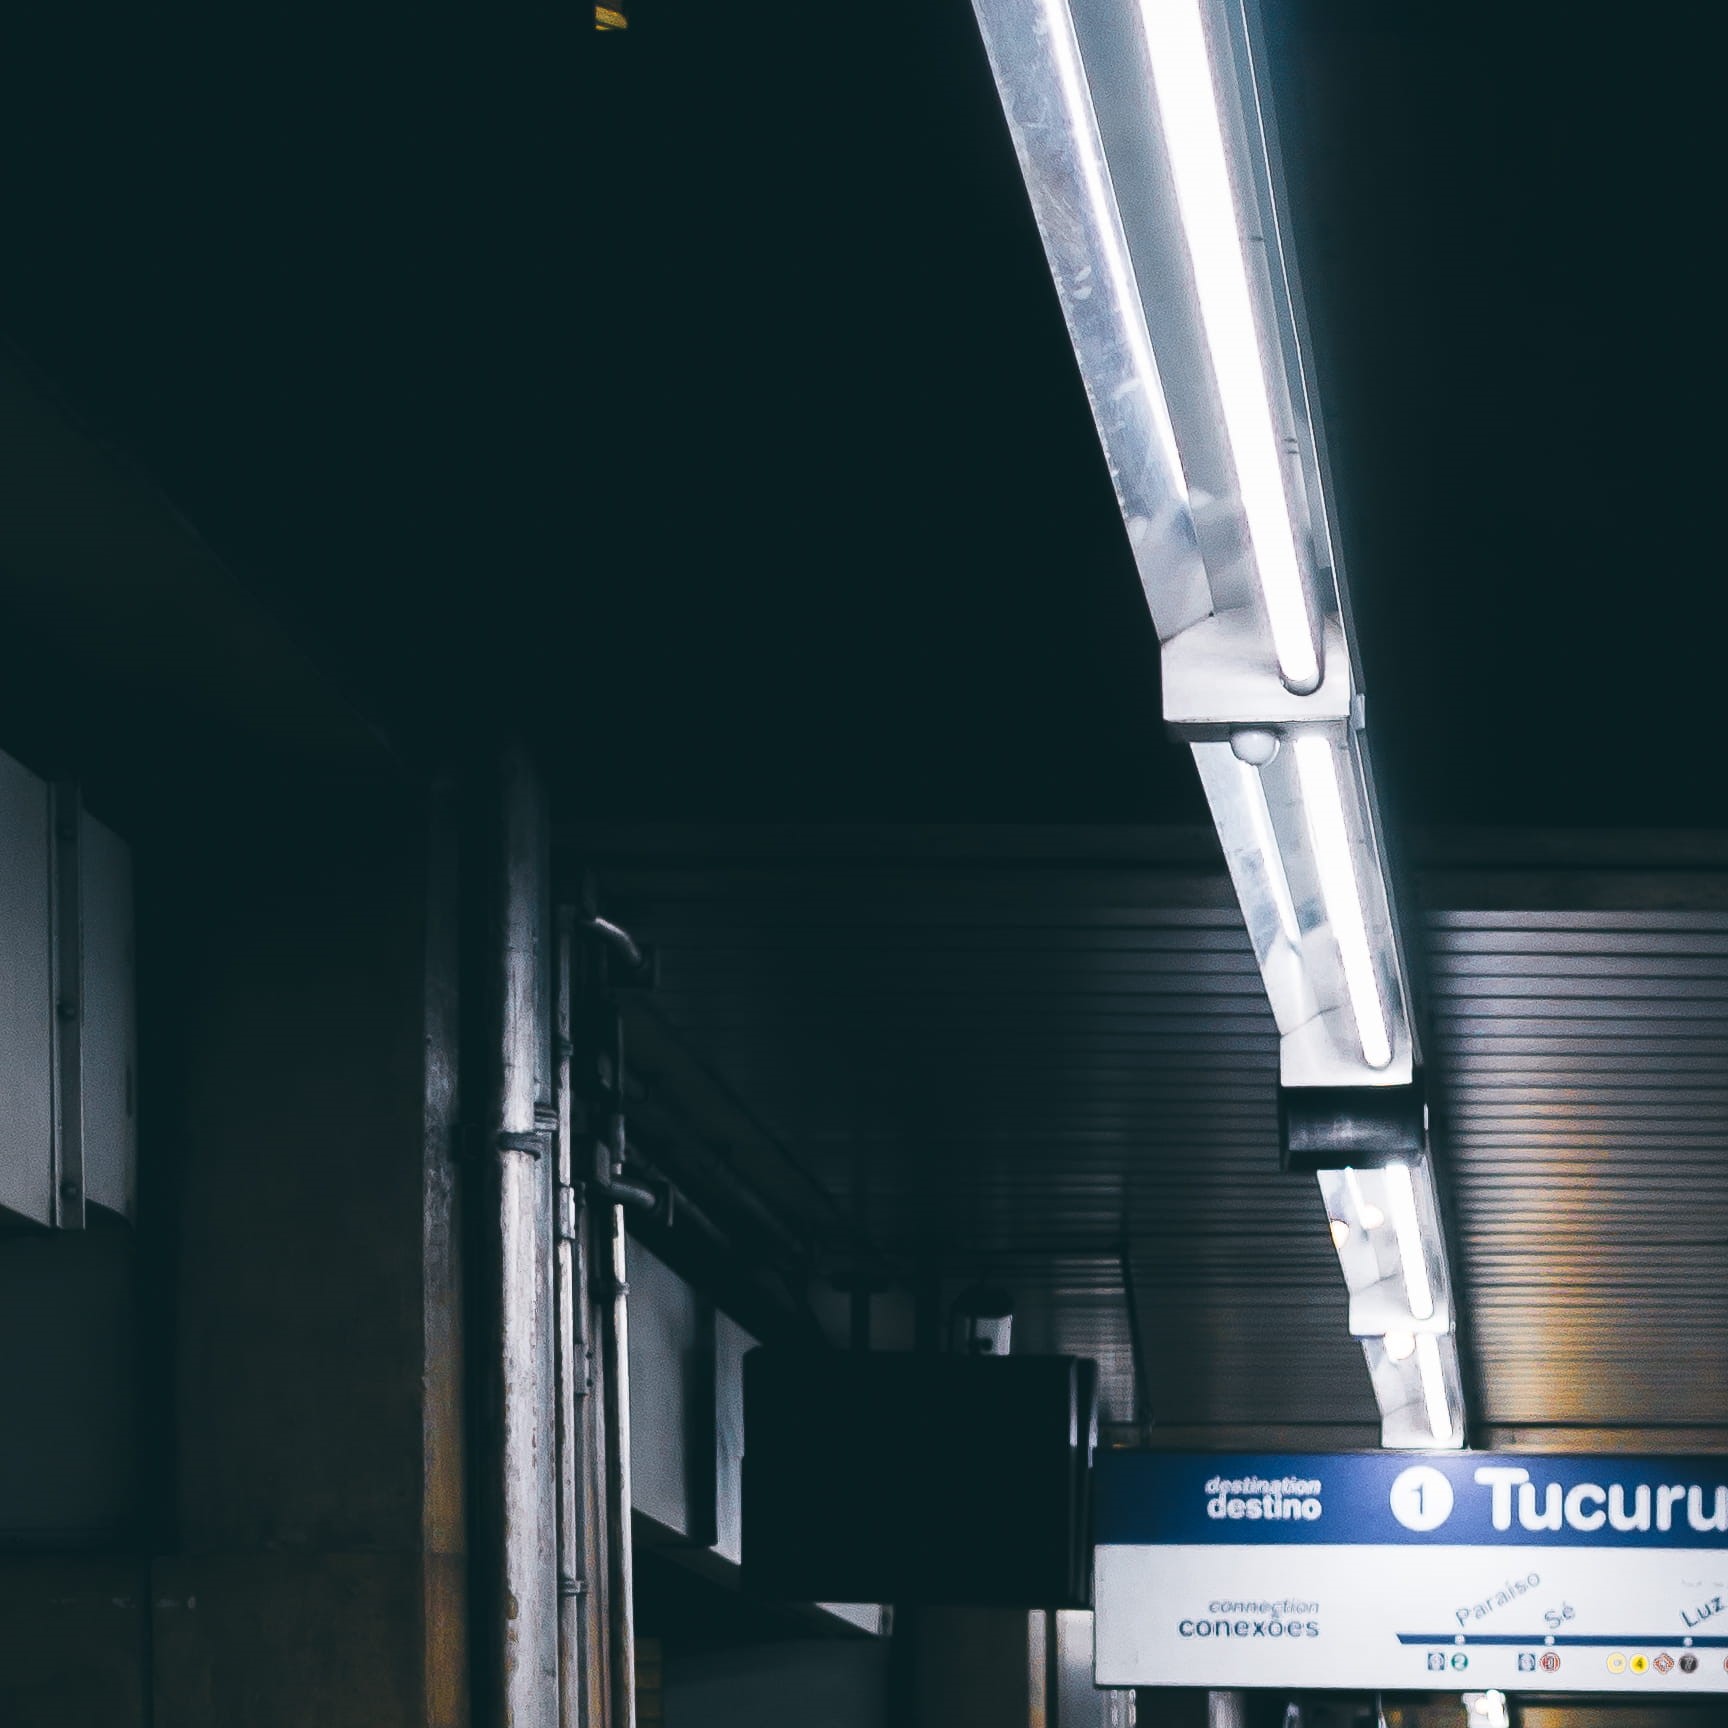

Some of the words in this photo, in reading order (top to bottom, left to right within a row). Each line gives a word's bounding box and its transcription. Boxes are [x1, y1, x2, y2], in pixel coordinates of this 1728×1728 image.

[1205, 1475, 1321, 1495] destination
[1206, 1493, 1322, 1520] destino
[1209, 1599, 1319, 1614] connection
[1680, 1596, 1724, 1628] Luz
[1178, 1611, 1320, 1638] conexões
